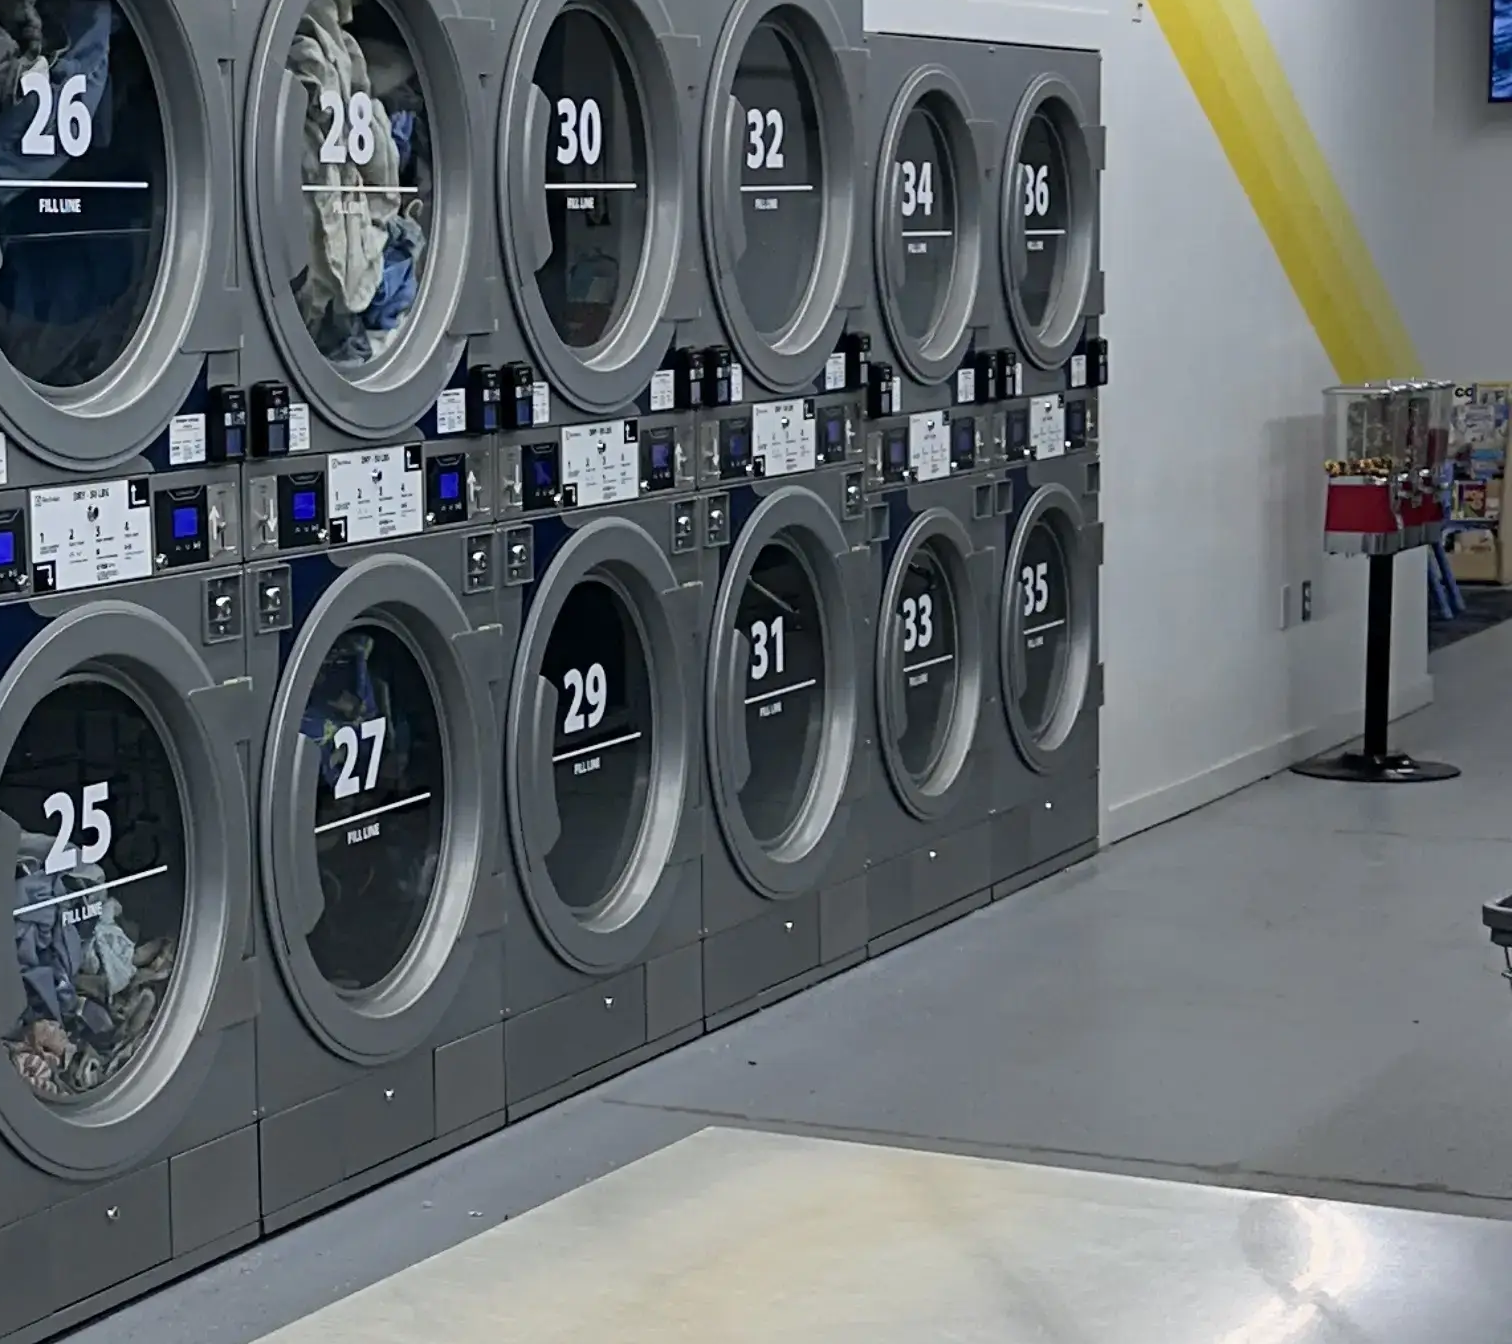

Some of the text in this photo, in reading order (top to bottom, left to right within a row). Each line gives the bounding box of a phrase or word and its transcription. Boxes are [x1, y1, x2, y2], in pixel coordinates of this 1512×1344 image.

[20, 72, 92, 157] 26
[320, 90, 374, 165] 28
[557, 97, 602, 165] 30
[747, 108, 784, 169] 32
[39, 199, 81, 213] FILL LINE
[902, 161, 934, 216] 34
[1024, 165, 1049, 216] 36
[1022, 562, 1048, 616] 35
[751, 616, 784, 680] 31
[903, 594, 933, 653] 33
[563, 662, 607, 734] 29
[334, 717, 386, 800] 27
[43, 781, 112, 875] 25
[347, 822, 380, 845] FILL LINE
[62, 901, 102, 926] FILL LINE
